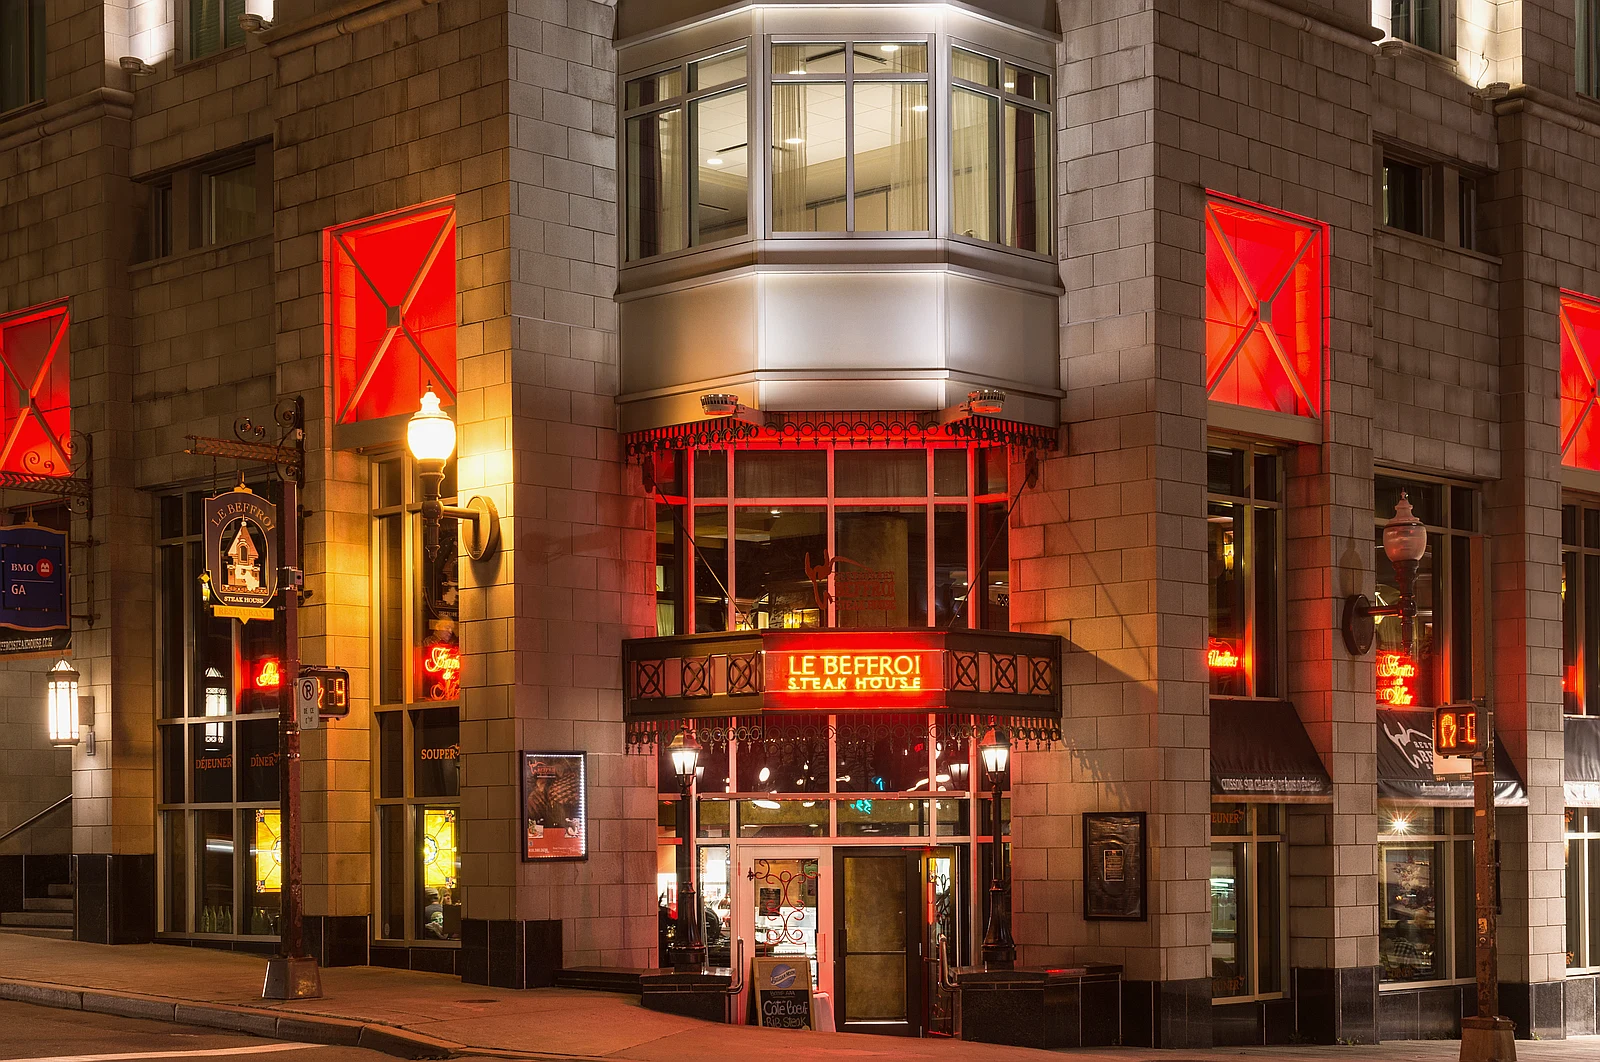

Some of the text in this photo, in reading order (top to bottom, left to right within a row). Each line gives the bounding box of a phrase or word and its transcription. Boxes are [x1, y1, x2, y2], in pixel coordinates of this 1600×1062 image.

[211, 502, 276, 532] LE BEFFROI
[11, 563, 34, 572] BMO
[11, 584, 26, 595] GA
[218, 607, 270, 618] RESTAURANT
[788, 655, 921, 675] LE BEFFROI
[788, 677, 921, 690] STEAK HOUSE
[421, 749, 456, 760] SOUPER
[195, 753, 274, 771] DÉJEUNER DÎNER
